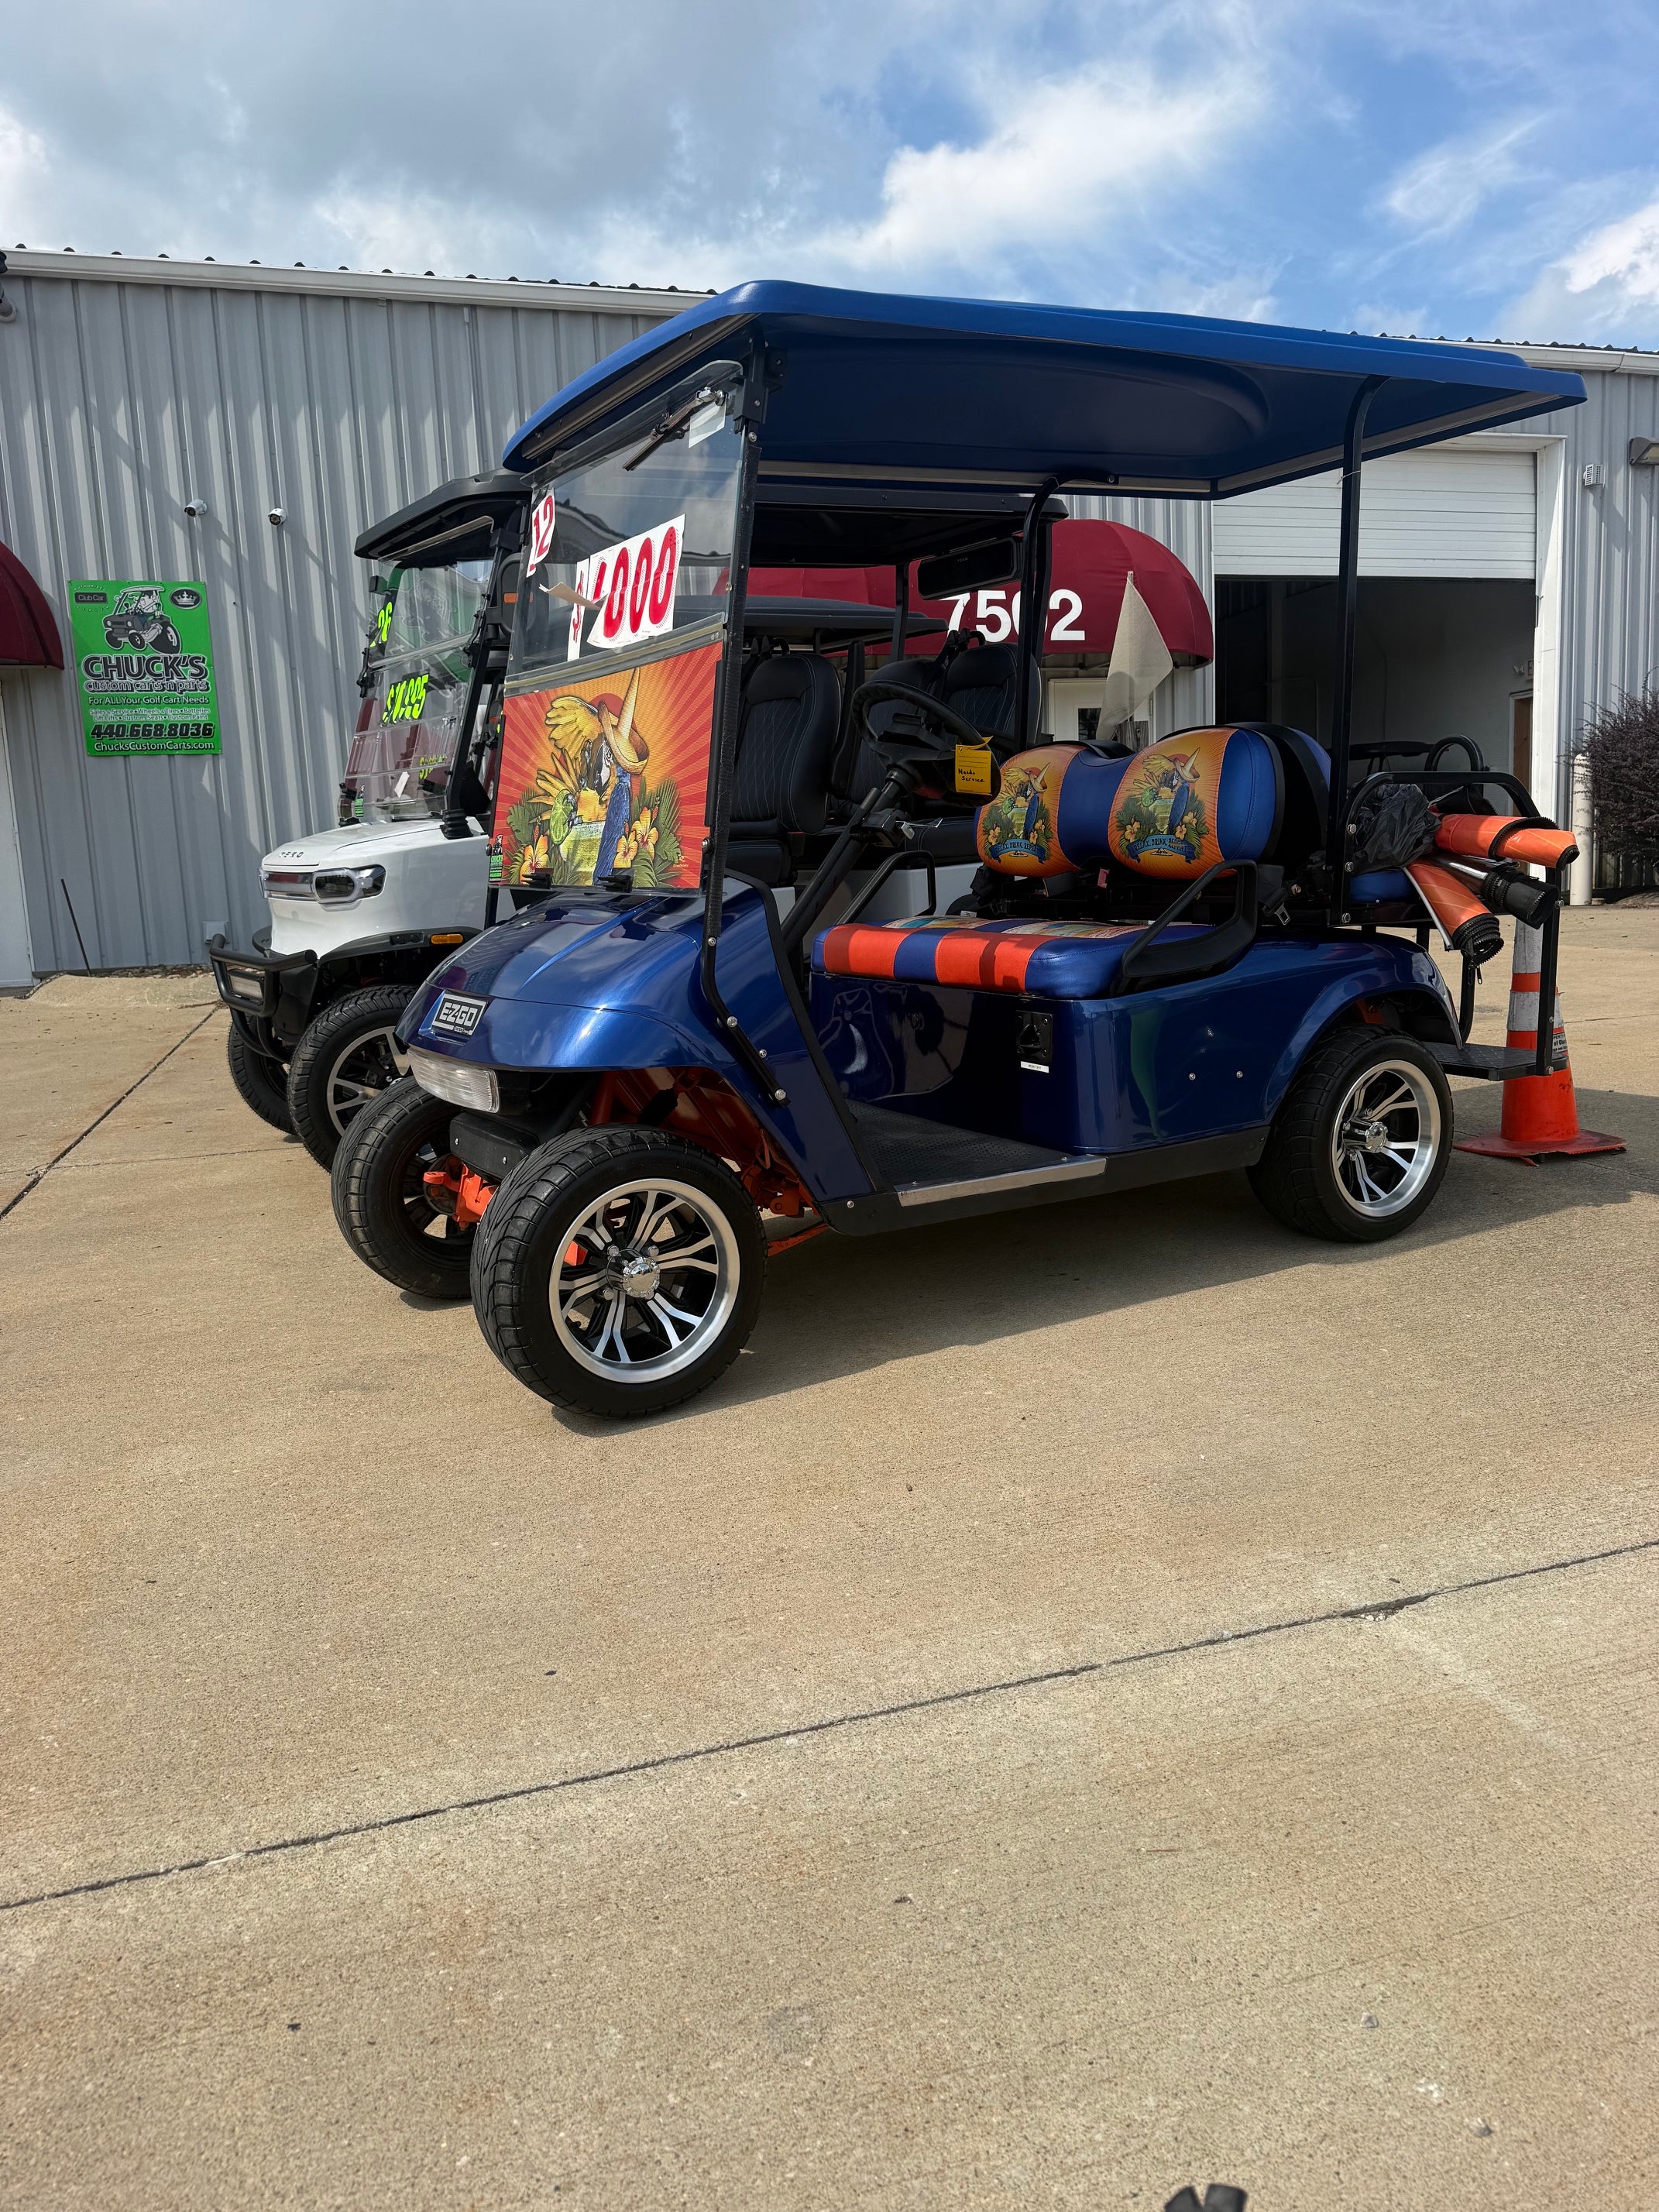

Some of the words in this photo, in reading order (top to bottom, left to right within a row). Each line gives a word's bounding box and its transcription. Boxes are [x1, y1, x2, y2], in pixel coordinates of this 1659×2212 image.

[83, 654, 208, 679] CHUCK'S
[86, 679, 132, 692] custom
[177, 678, 209, 694] parts
[91, 723, 215, 740] 440.668.8036
[94, 740, 215, 751] ChucksCustomCarts.com
